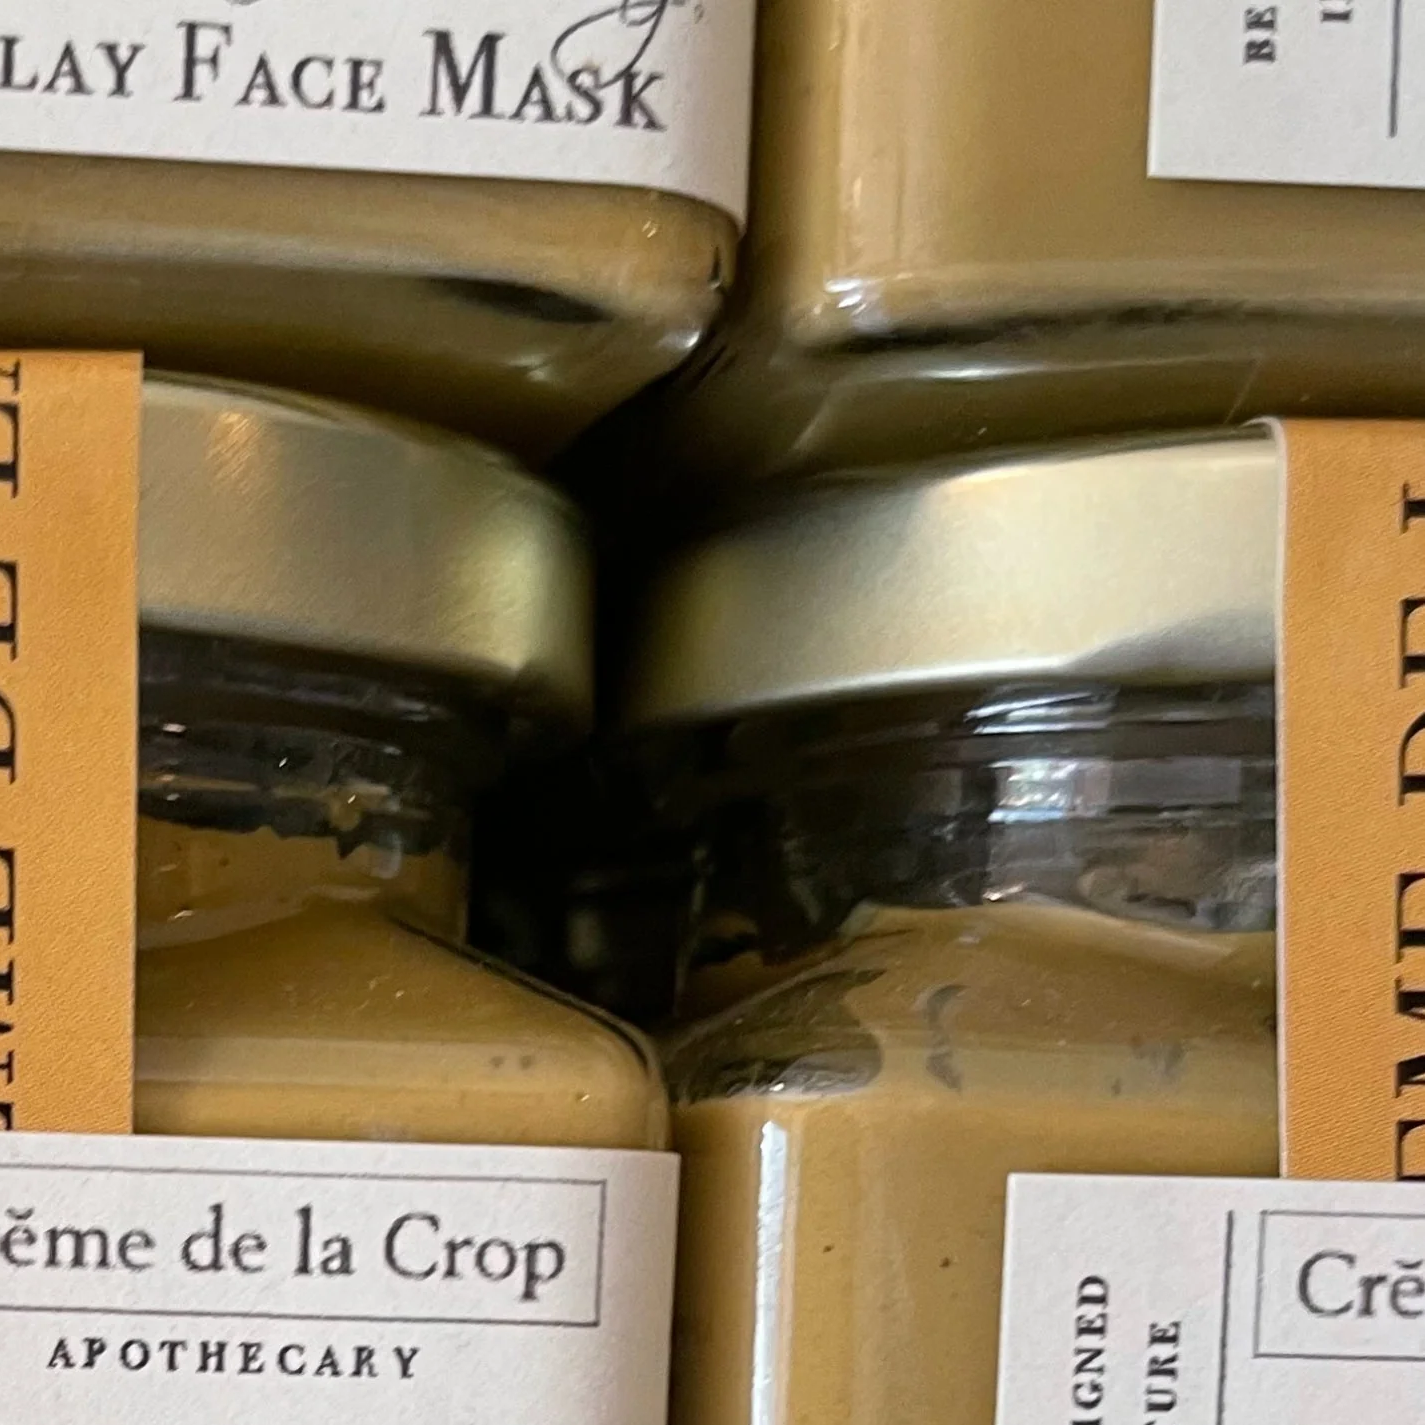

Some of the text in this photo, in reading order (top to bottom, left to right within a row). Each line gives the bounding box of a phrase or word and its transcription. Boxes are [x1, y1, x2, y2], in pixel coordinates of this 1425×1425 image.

[180, 1203, 268, 1275] de
[292, 1204, 356, 1278] la
[383, 1212, 567, 1302] Crop
[46, 1336, 421, 1380] APOTHECARY
